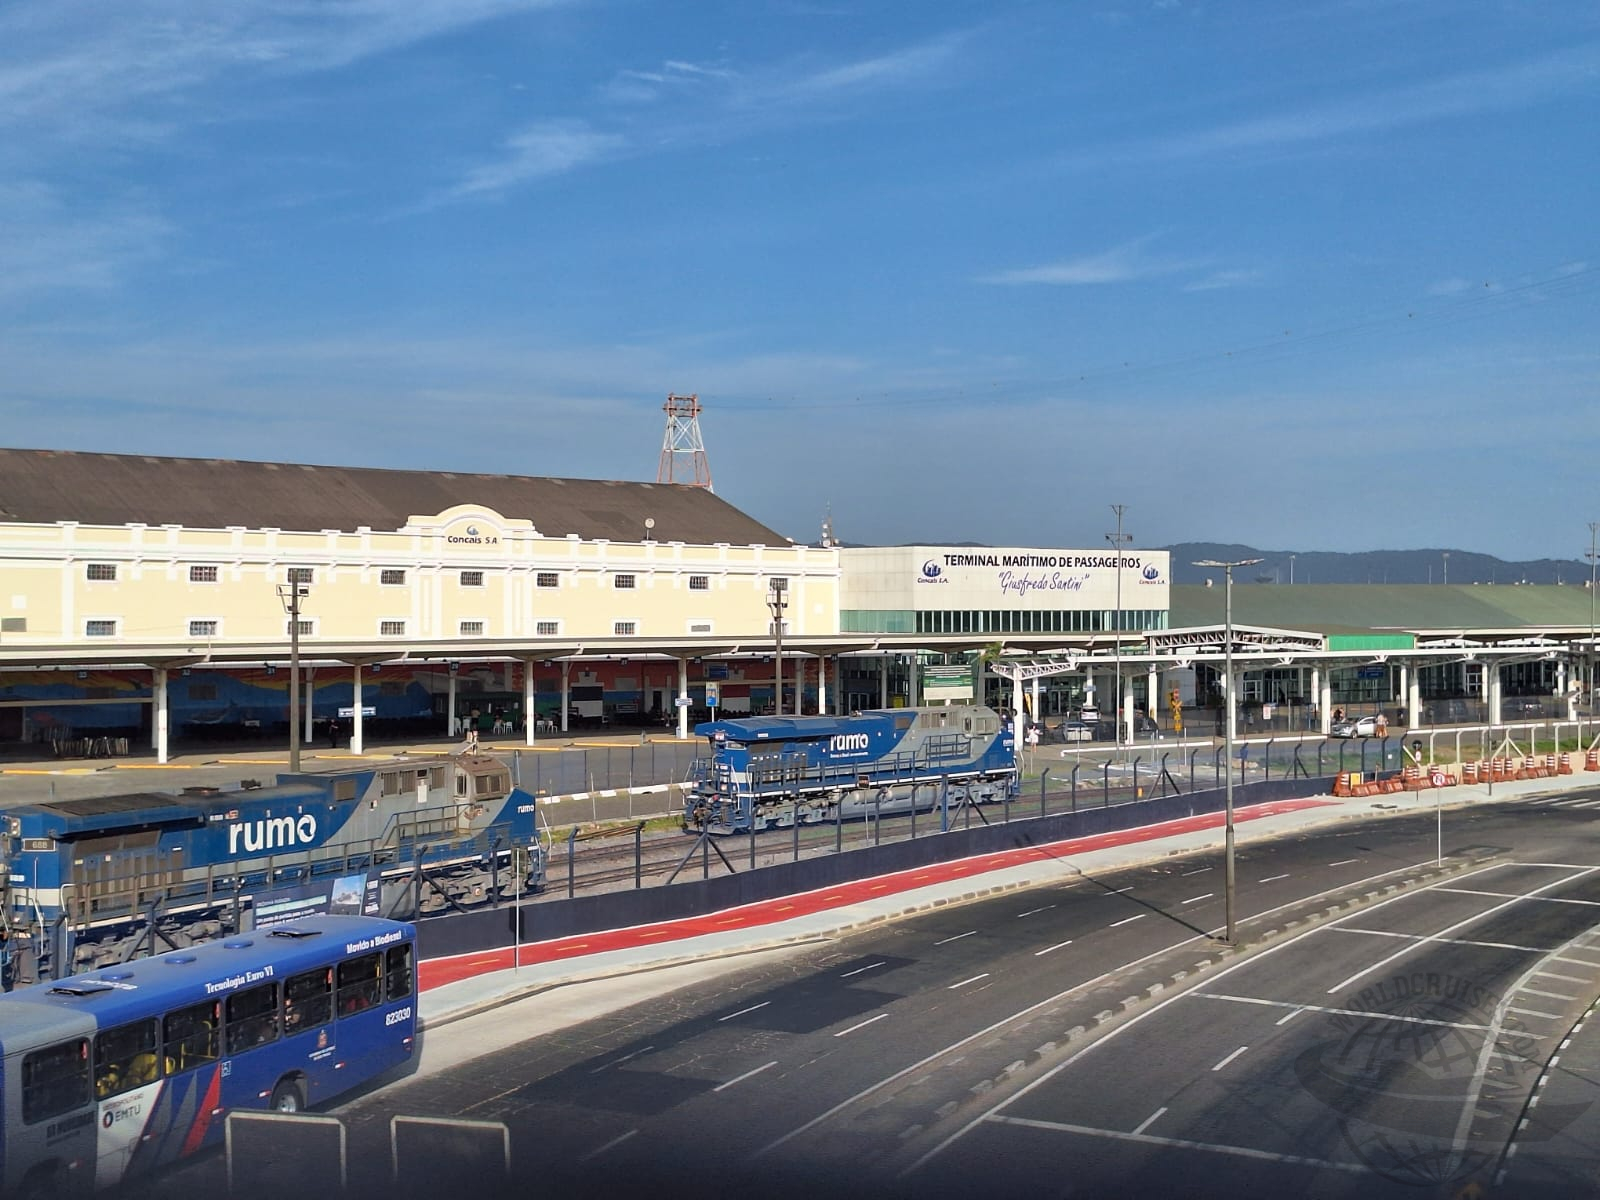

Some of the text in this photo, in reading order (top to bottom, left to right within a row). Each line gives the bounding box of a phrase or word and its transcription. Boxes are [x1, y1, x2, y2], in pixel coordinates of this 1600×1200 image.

[447, 535, 482, 544] Concais
[944, 553, 1141, 569] TERMINAL MARÍTIMO DE PASSAGEROS
[829, 733, 869, 751] rumo
[517, 804, 535, 814] rumo
[229, 814, 317, 854] rumo
[346, 939, 370, 954] Movido
[370, 939, 375, 948] a
[205, 965, 274, 994] Tecnologia Euro VI
[385, 1006, 411, 1026] 823030
[115, 1103, 141, 1122] EMTU
